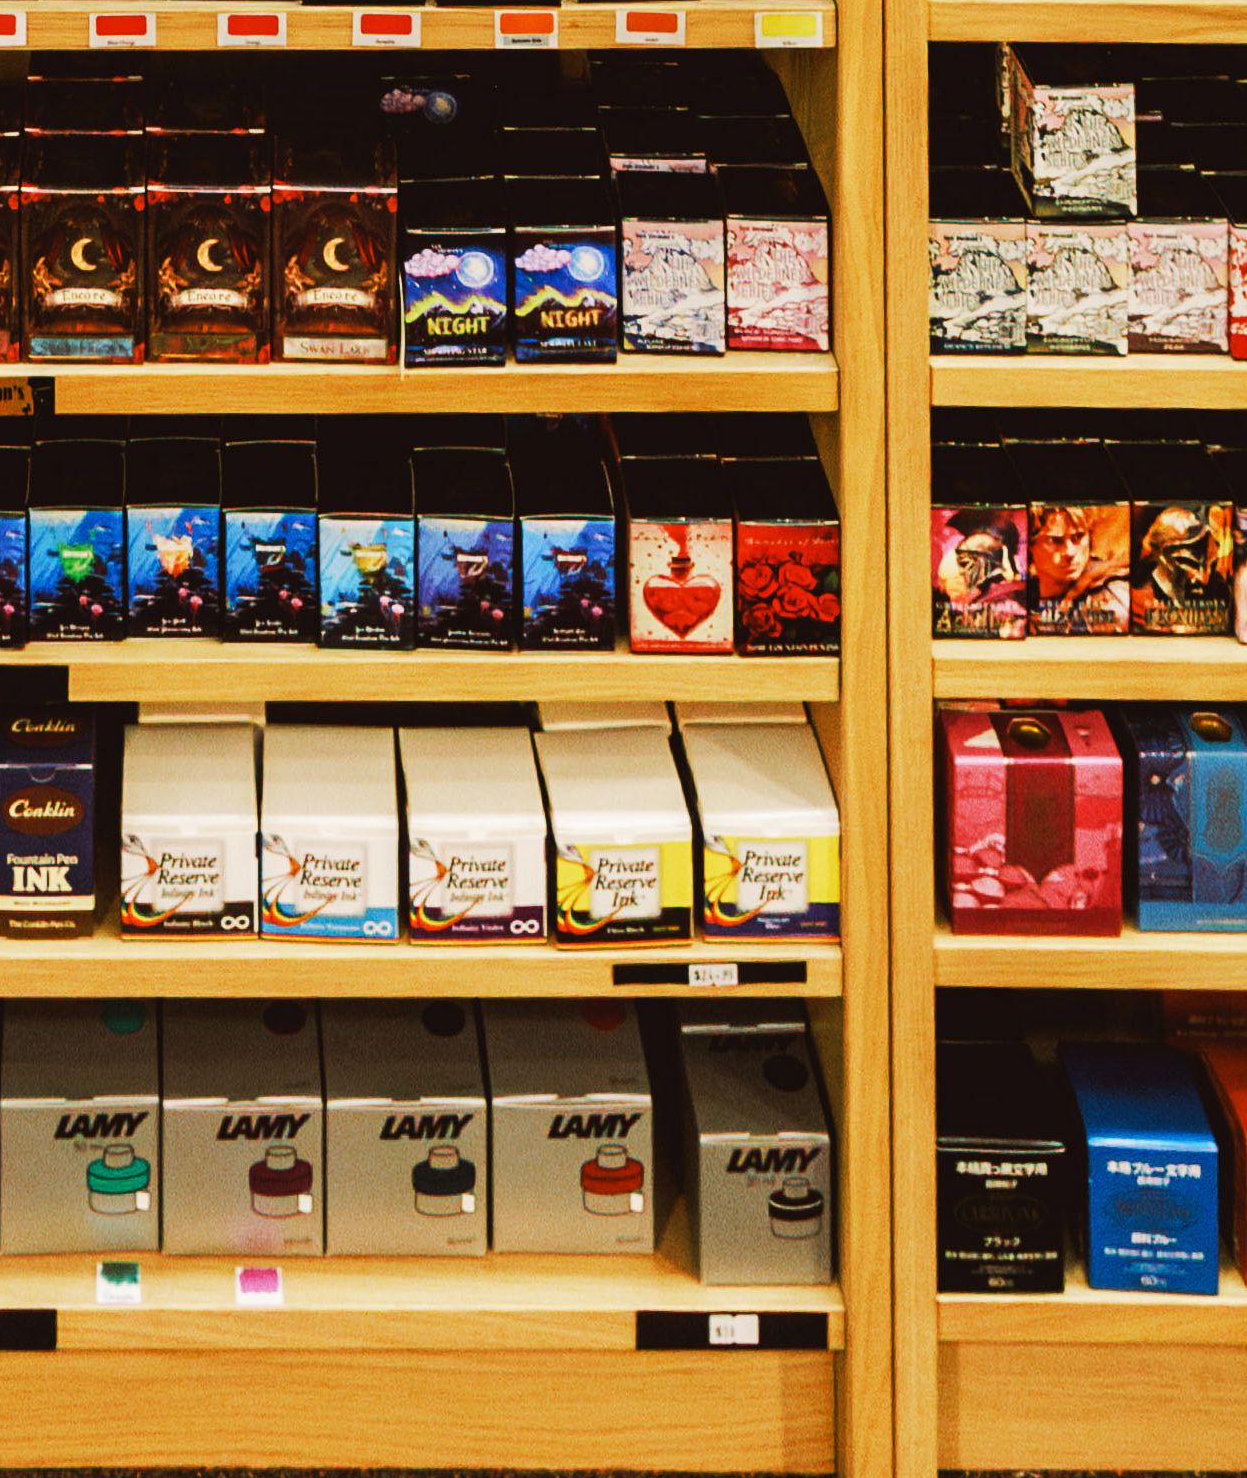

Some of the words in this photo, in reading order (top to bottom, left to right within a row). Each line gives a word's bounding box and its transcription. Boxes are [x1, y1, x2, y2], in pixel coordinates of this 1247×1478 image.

[427, 317, 490, 335] NIGHT
[540, 311, 600, 328] NIGHT
[9, 800, 75, 818] Conklin
[7, 854, 51, 865] Fountain
[55, 854, 78, 866] Pen
[160, 854, 217, 869] Private
[302, 857, 359, 872] Private
[450, 858, 505, 873] Private
[597, 860, 653, 874] Private
[744, 853, 800, 867] Private
[15, 866, 73, 892] INK
[158, 870, 219, 885] Reserve
[300, 873, 361, 888] Reserve
[447, 875, 509, 889] Reserve
[595, 874, 656, 890] Reserve
[742, 868, 803, 884] Reserve
[54, 1112, 147, 1139] LAMY
[217, 1114, 311, 1140] LAMY
[380, 1115, 474, 1140] LAMY
[548, 1113, 642, 1140] LAMY
[726, 1149, 819, 1173] LAMY
